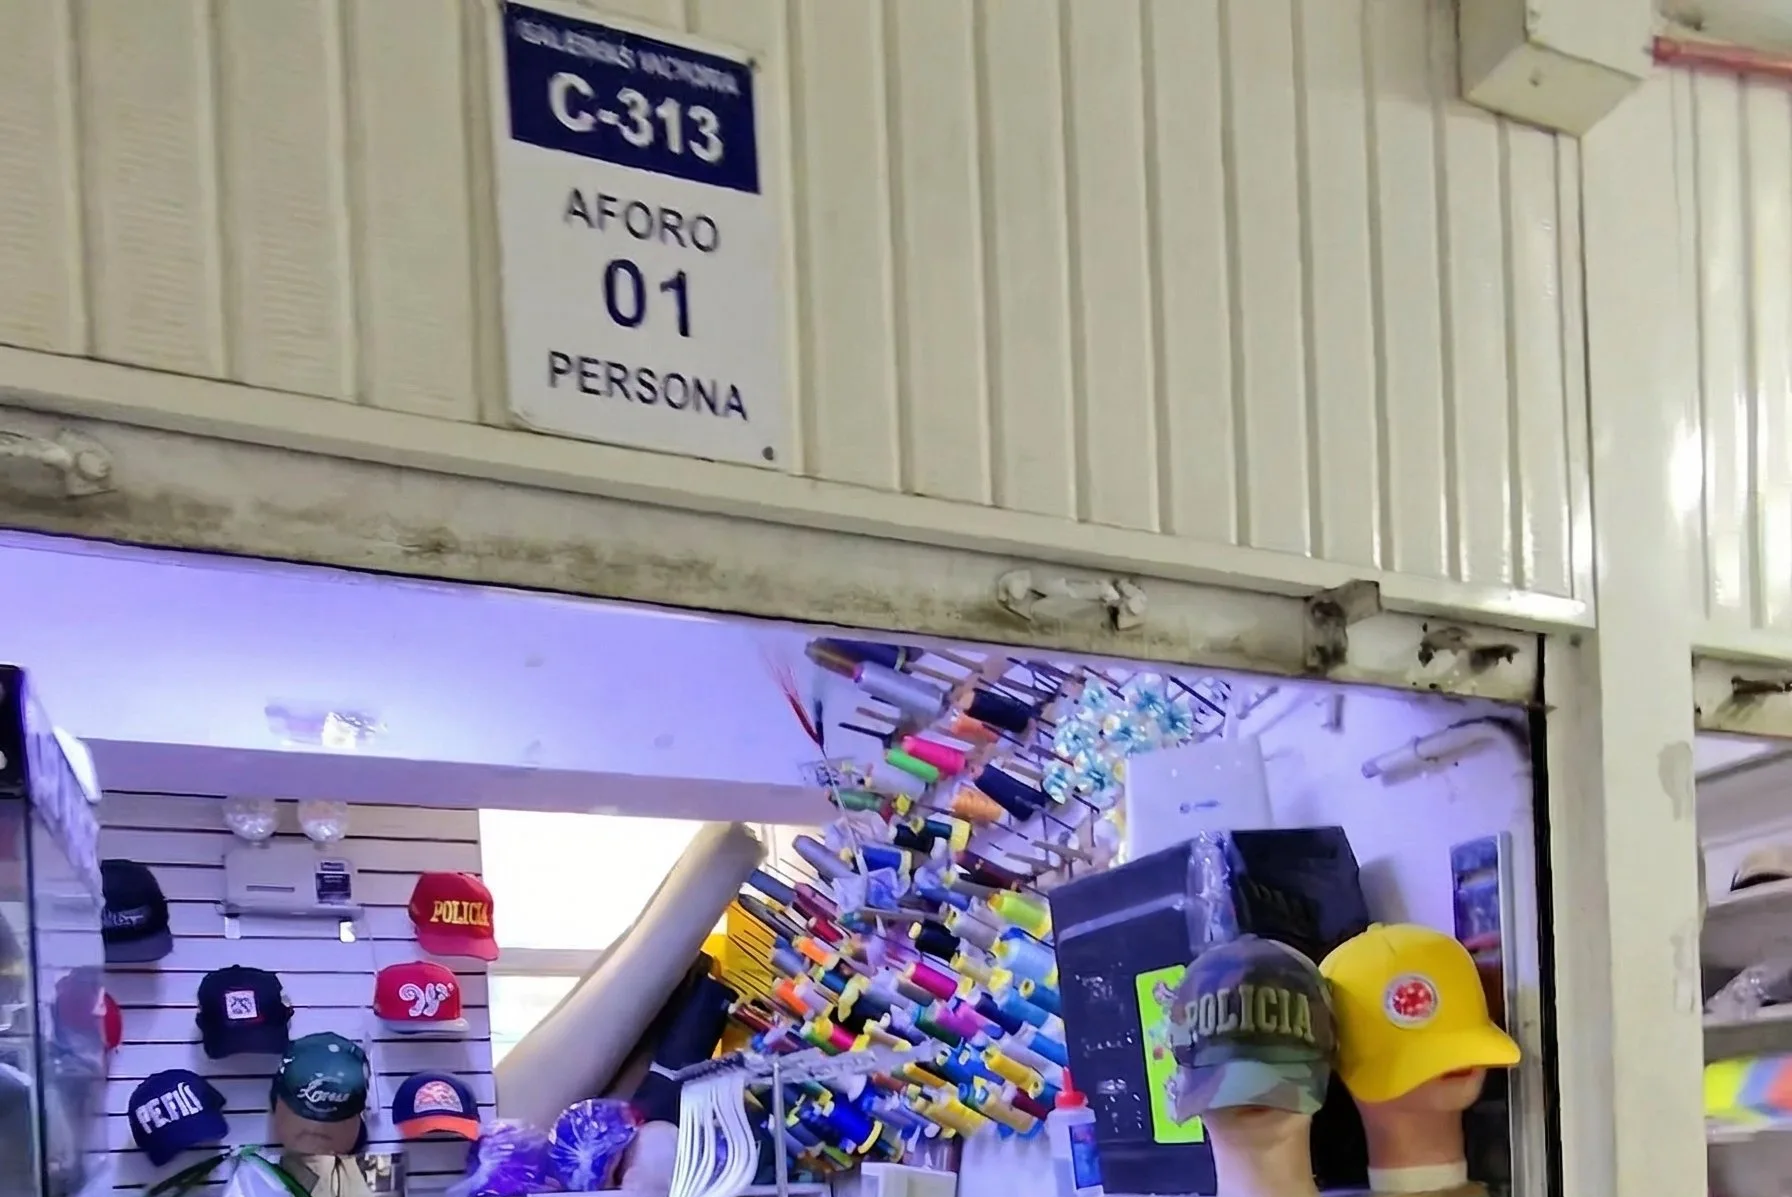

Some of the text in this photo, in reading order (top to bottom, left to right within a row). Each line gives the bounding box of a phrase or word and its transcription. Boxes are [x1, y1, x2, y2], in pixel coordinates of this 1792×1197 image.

[549, 71, 724, 164] C-313
[563, 187, 720, 252] AFORO
[604, 258, 691, 337] 01
[547, 350, 749, 422] PERSONA
[430, 900, 490, 926] POLICIA
[1185, 984, 1315, 1043] POLICIA
